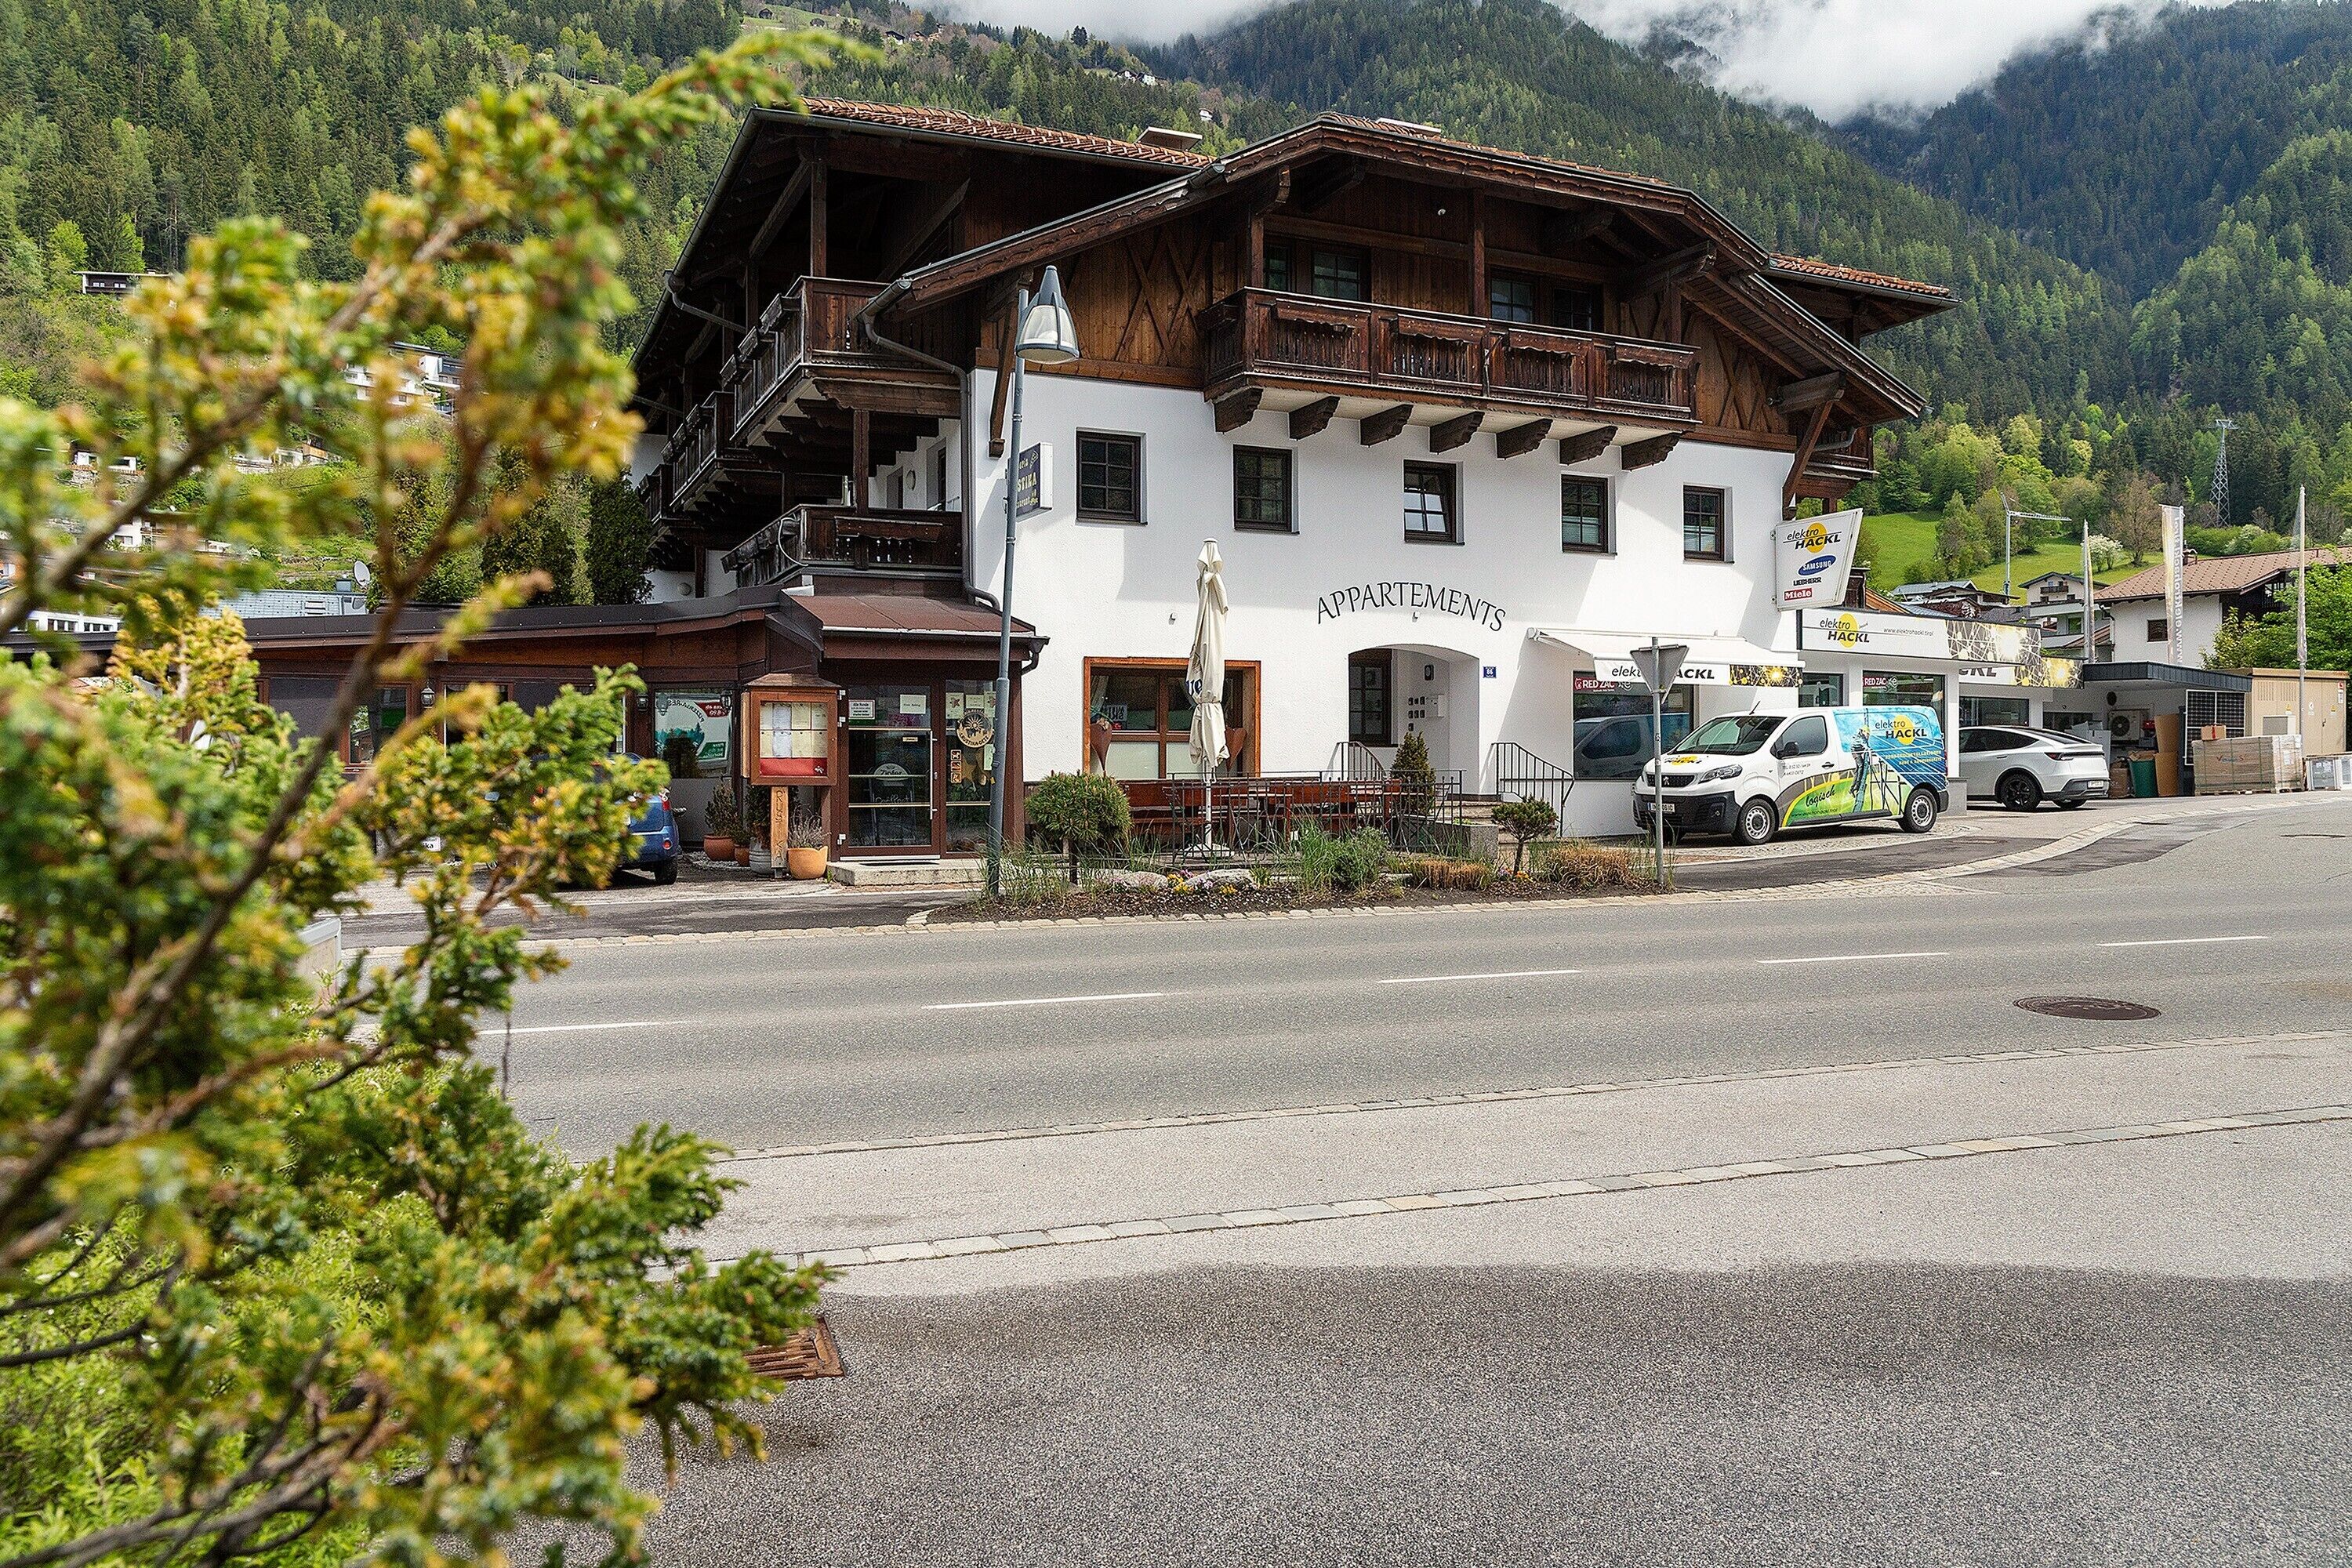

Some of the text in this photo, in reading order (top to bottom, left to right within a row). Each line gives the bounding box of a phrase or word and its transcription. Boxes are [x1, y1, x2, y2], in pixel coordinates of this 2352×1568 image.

[1017, 472, 1037, 492] STIKA
[1787, 528, 1819, 541] elektro
[1795, 534, 1841, 550] HACKL
[1802, 560, 1831, 571] SAMSUNG
[1784, 590, 1812, 600] Miele
[1318, 582, 1506, 632] APPARTEMENTS
[1820, 618, 1851, 630] elektro
[1828, 630, 1870, 643] HACKL
[1675, 669, 1715, 679] ACKL
[1583, 680, 1599, 688] RED
[1864, 677, 1886, 686] RED ZAC
[1875, 720, 1906, 729] elektro
[1886, 728, 1927, 739] HACKL
[1806, 784, 1835, 808] logisch
